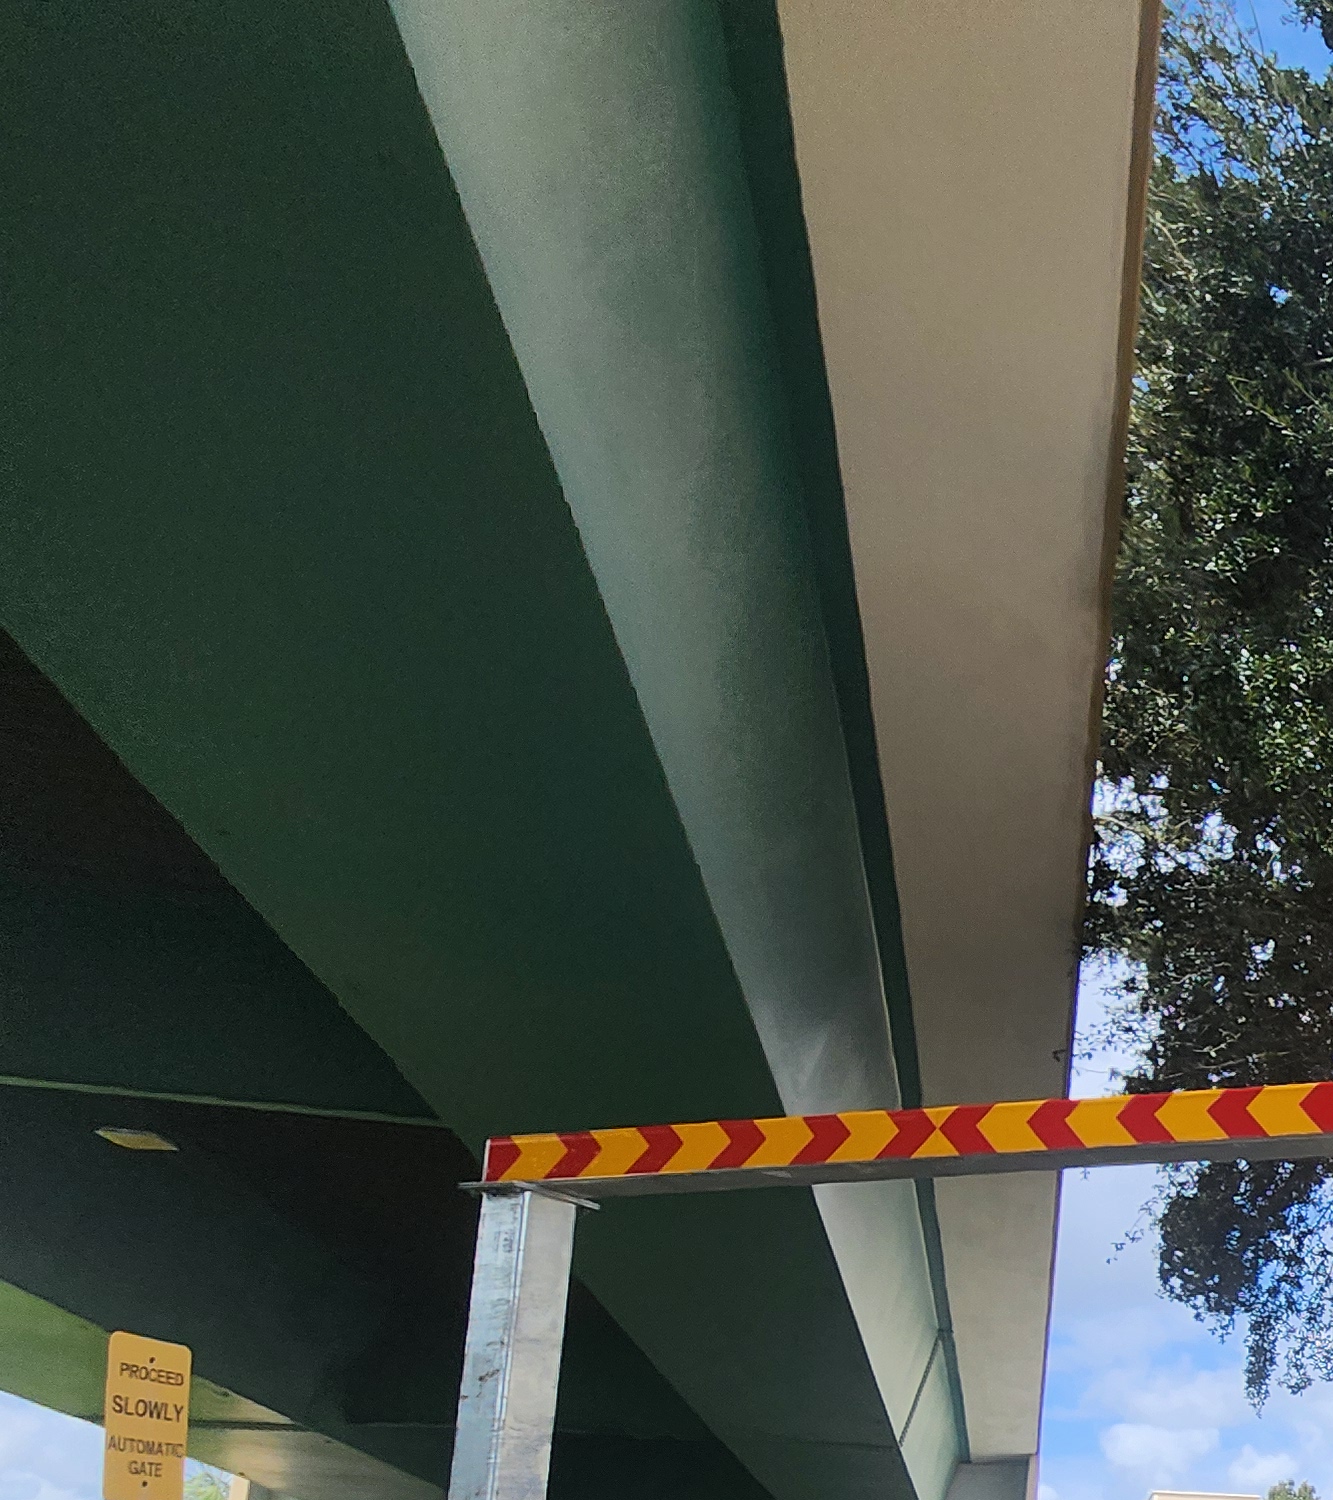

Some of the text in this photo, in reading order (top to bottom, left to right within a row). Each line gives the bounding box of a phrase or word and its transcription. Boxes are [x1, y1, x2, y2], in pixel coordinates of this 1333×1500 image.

[119, 1362, 184, 1386] PROCEED
[112, 1394, 184, 1422] SLOWLY
[108, 1434, 184, 1458] AUTOMATIC
[127, 1459, 163, 1477] GATE
